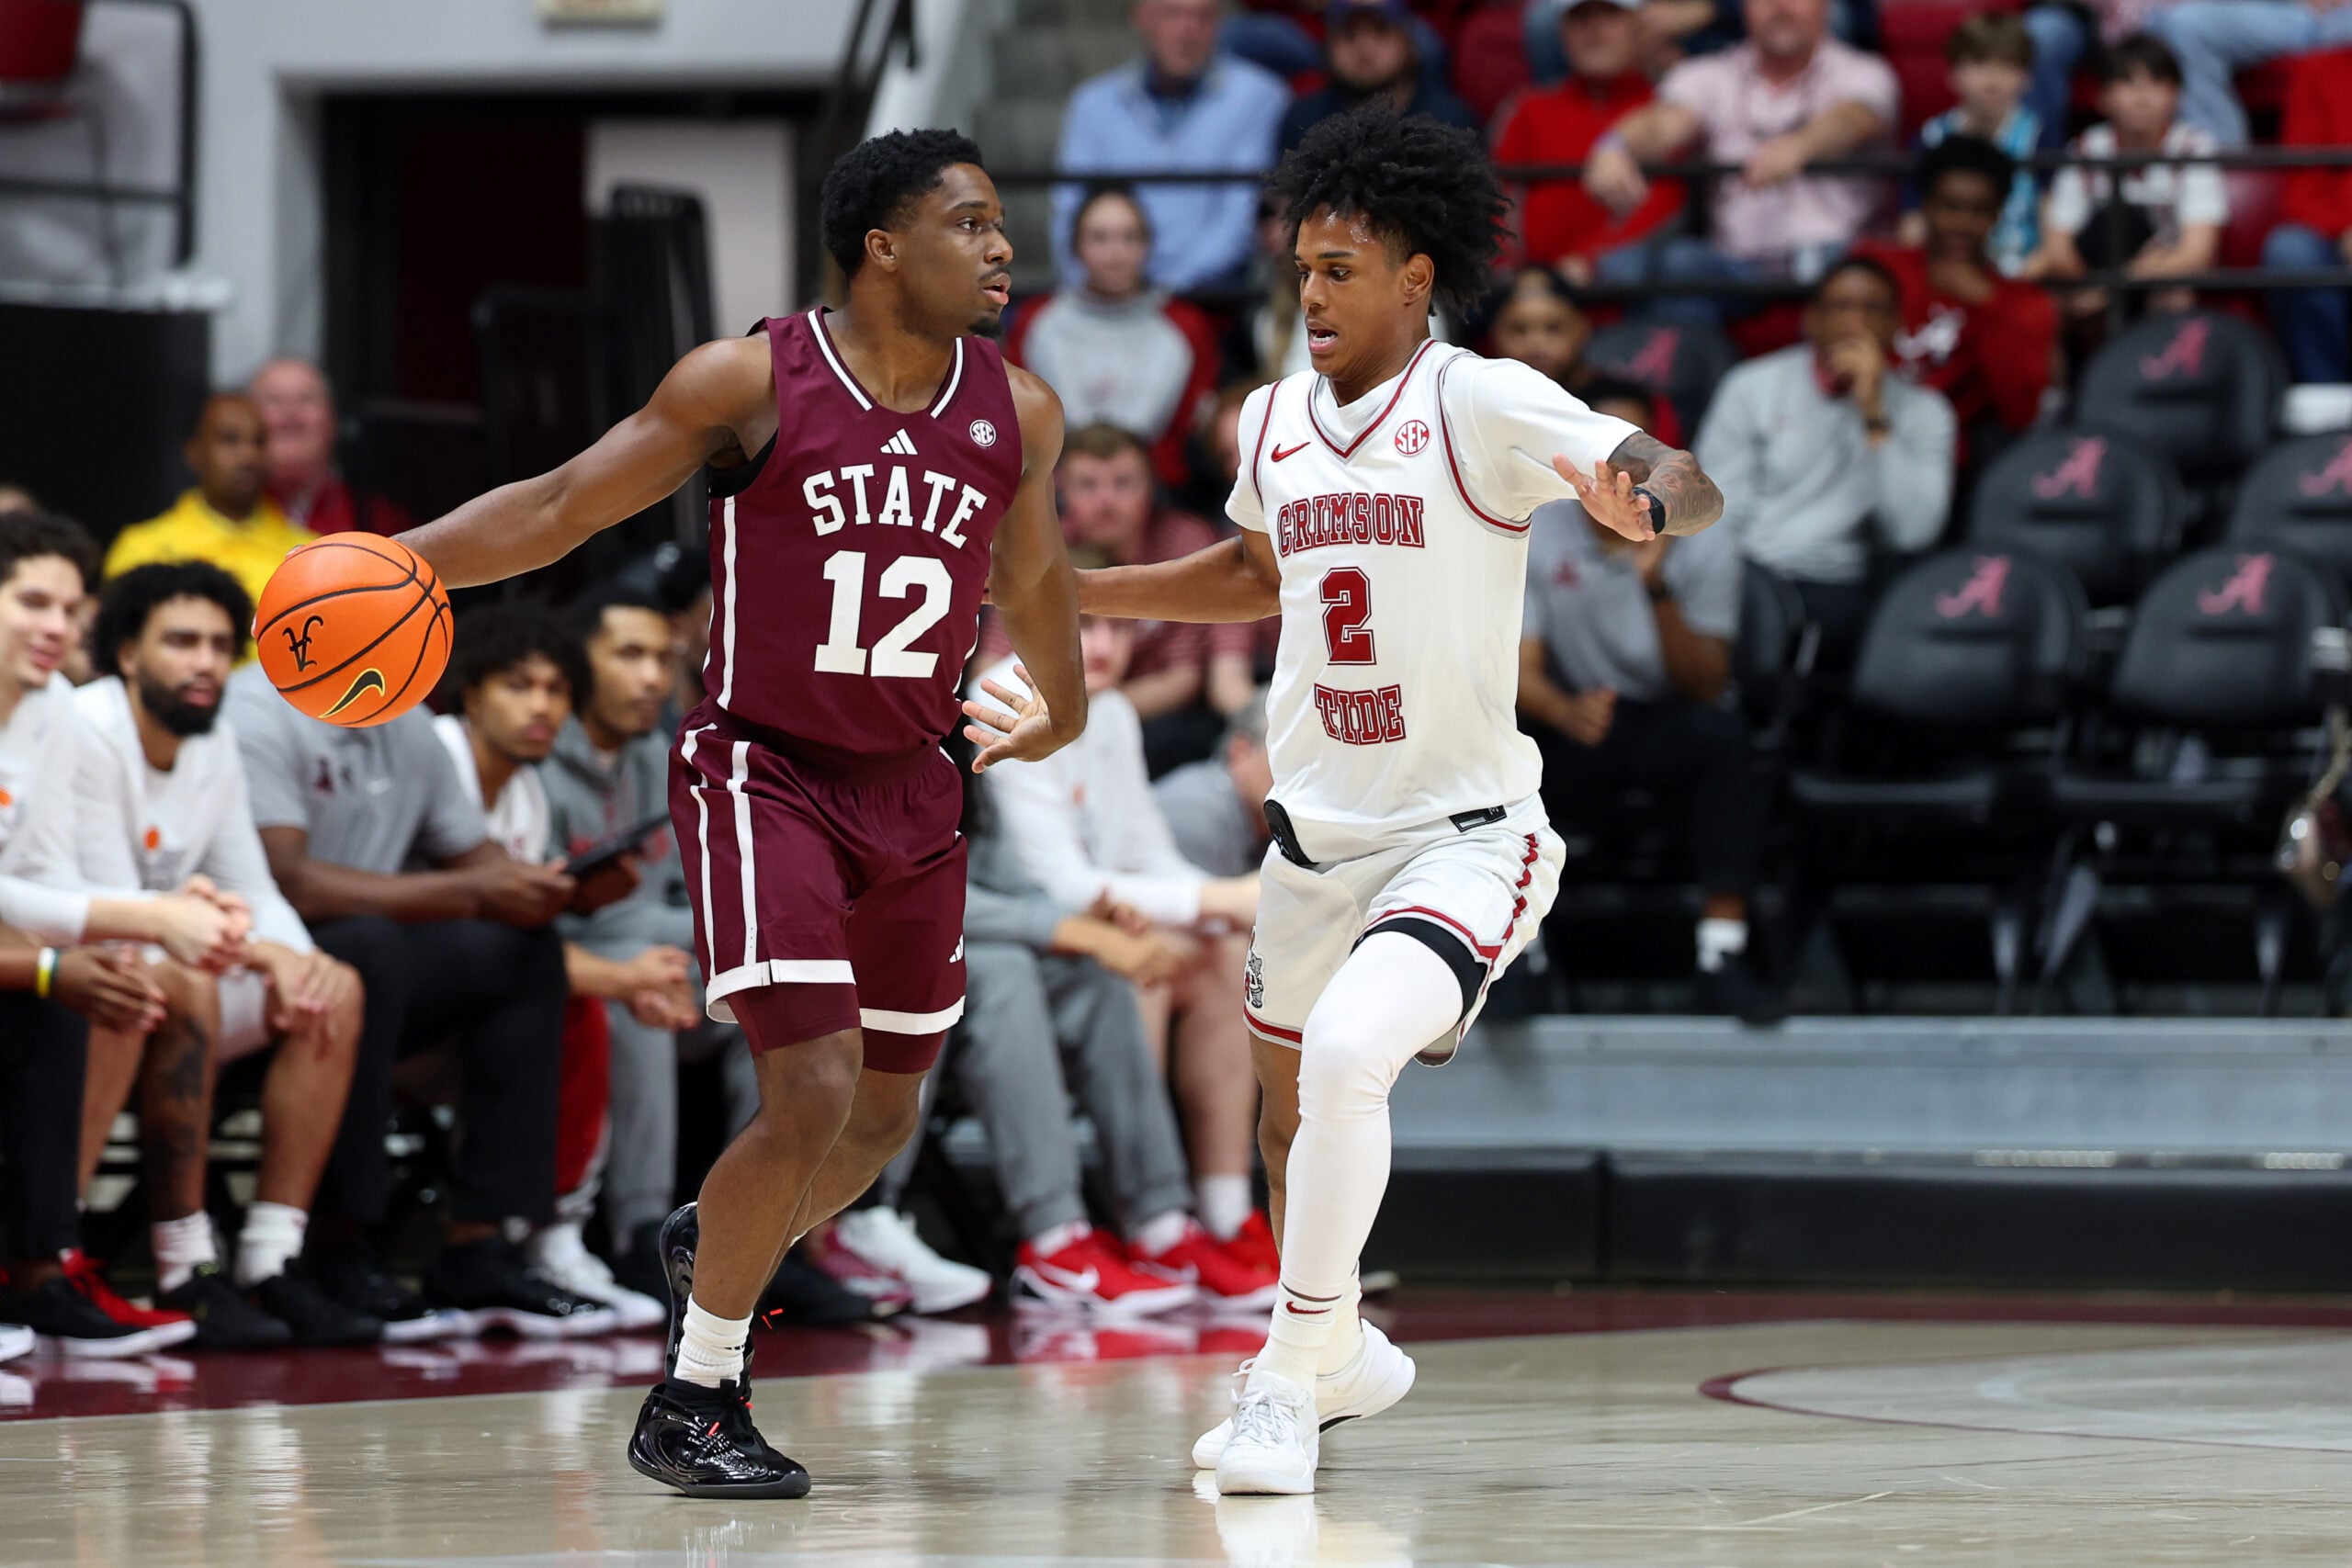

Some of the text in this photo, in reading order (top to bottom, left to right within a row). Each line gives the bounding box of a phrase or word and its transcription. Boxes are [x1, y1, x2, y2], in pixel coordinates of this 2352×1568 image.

[972, 422, 994, 445] SEC
[1396, 421, 1429, 454] SEC
[803, 464, 987, 548] STATE
[1277, 492, 1425, 558] CRIMSON
[814, 550, 953, 678] 12
[1318, 566, 1376, 665] 2
[1314, 683, 1406, 745] TIDE
